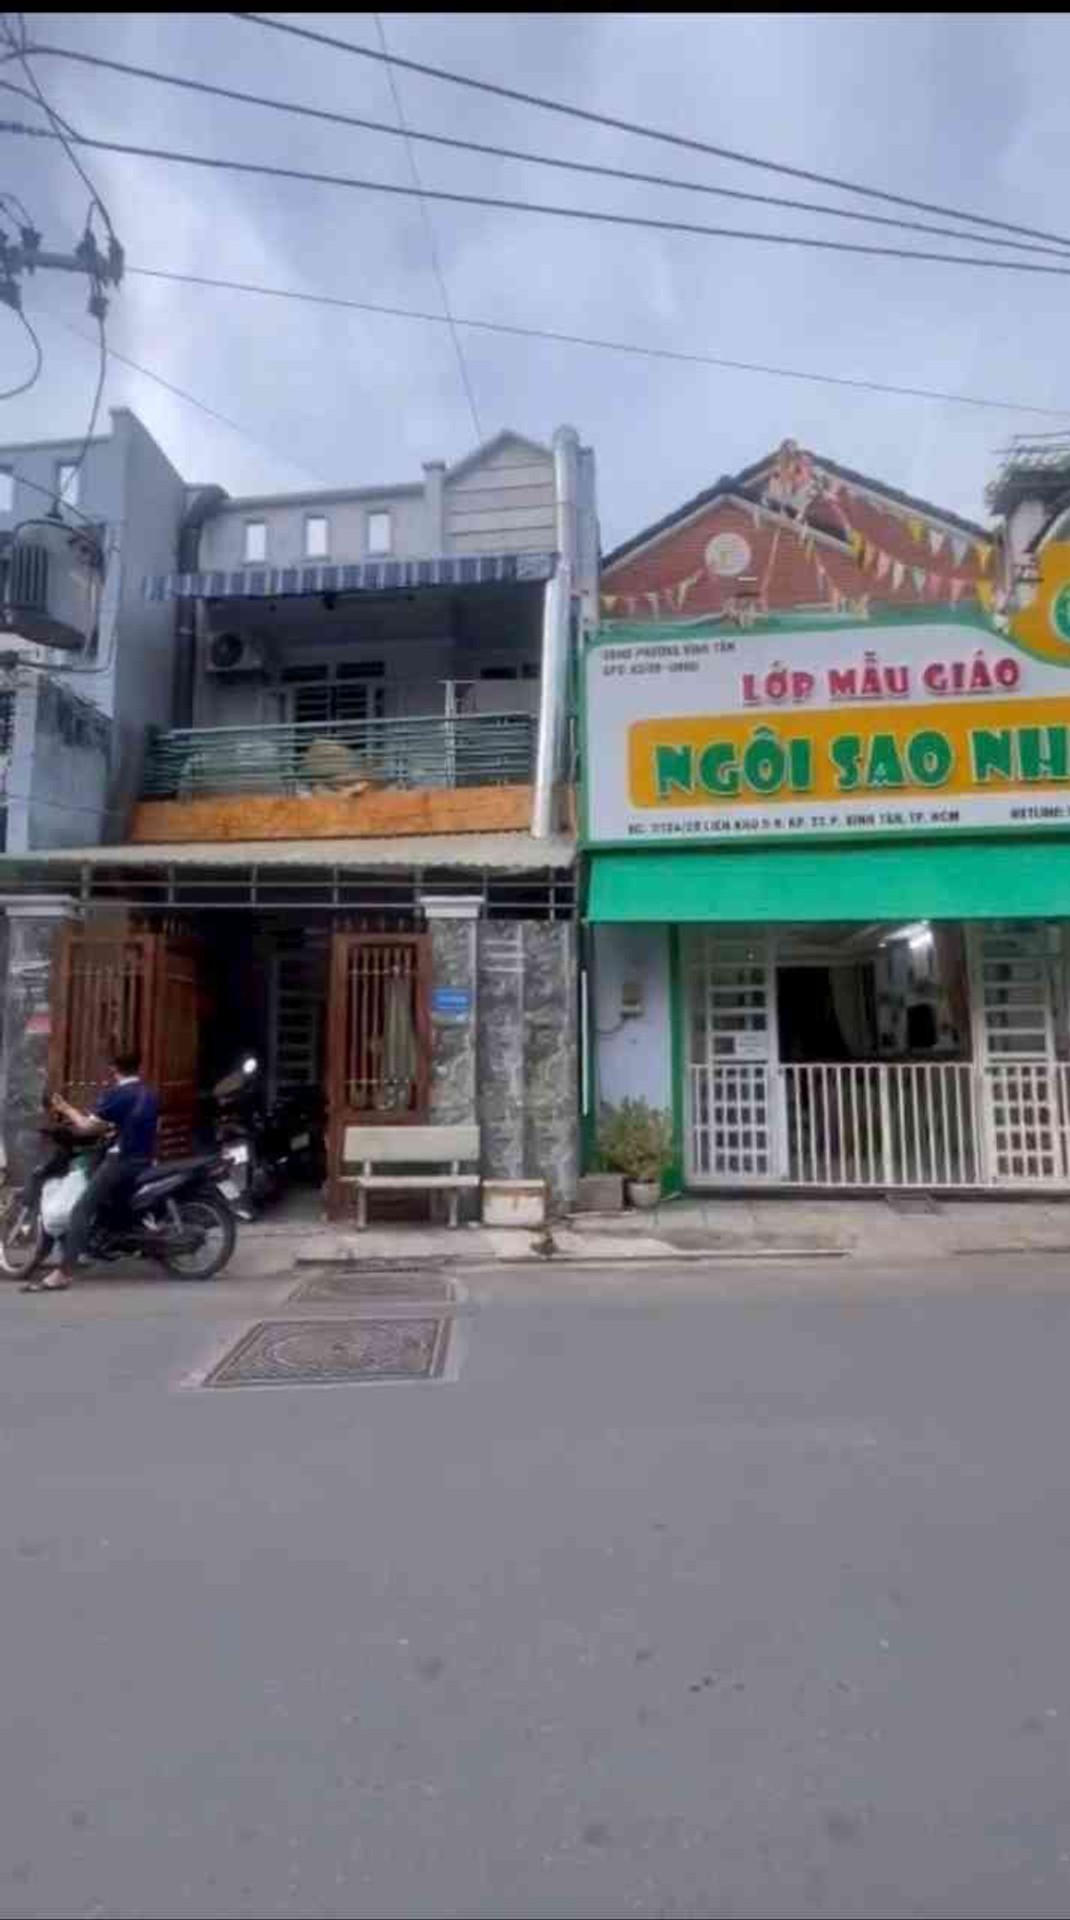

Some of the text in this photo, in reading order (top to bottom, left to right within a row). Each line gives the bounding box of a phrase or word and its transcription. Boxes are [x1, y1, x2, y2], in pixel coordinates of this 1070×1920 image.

[742, 649, 1021, 702] LỚP MẪU GIÁO
[654, 725, 813, 799] NGÔI
[830, 729, 955, 792] SAO
